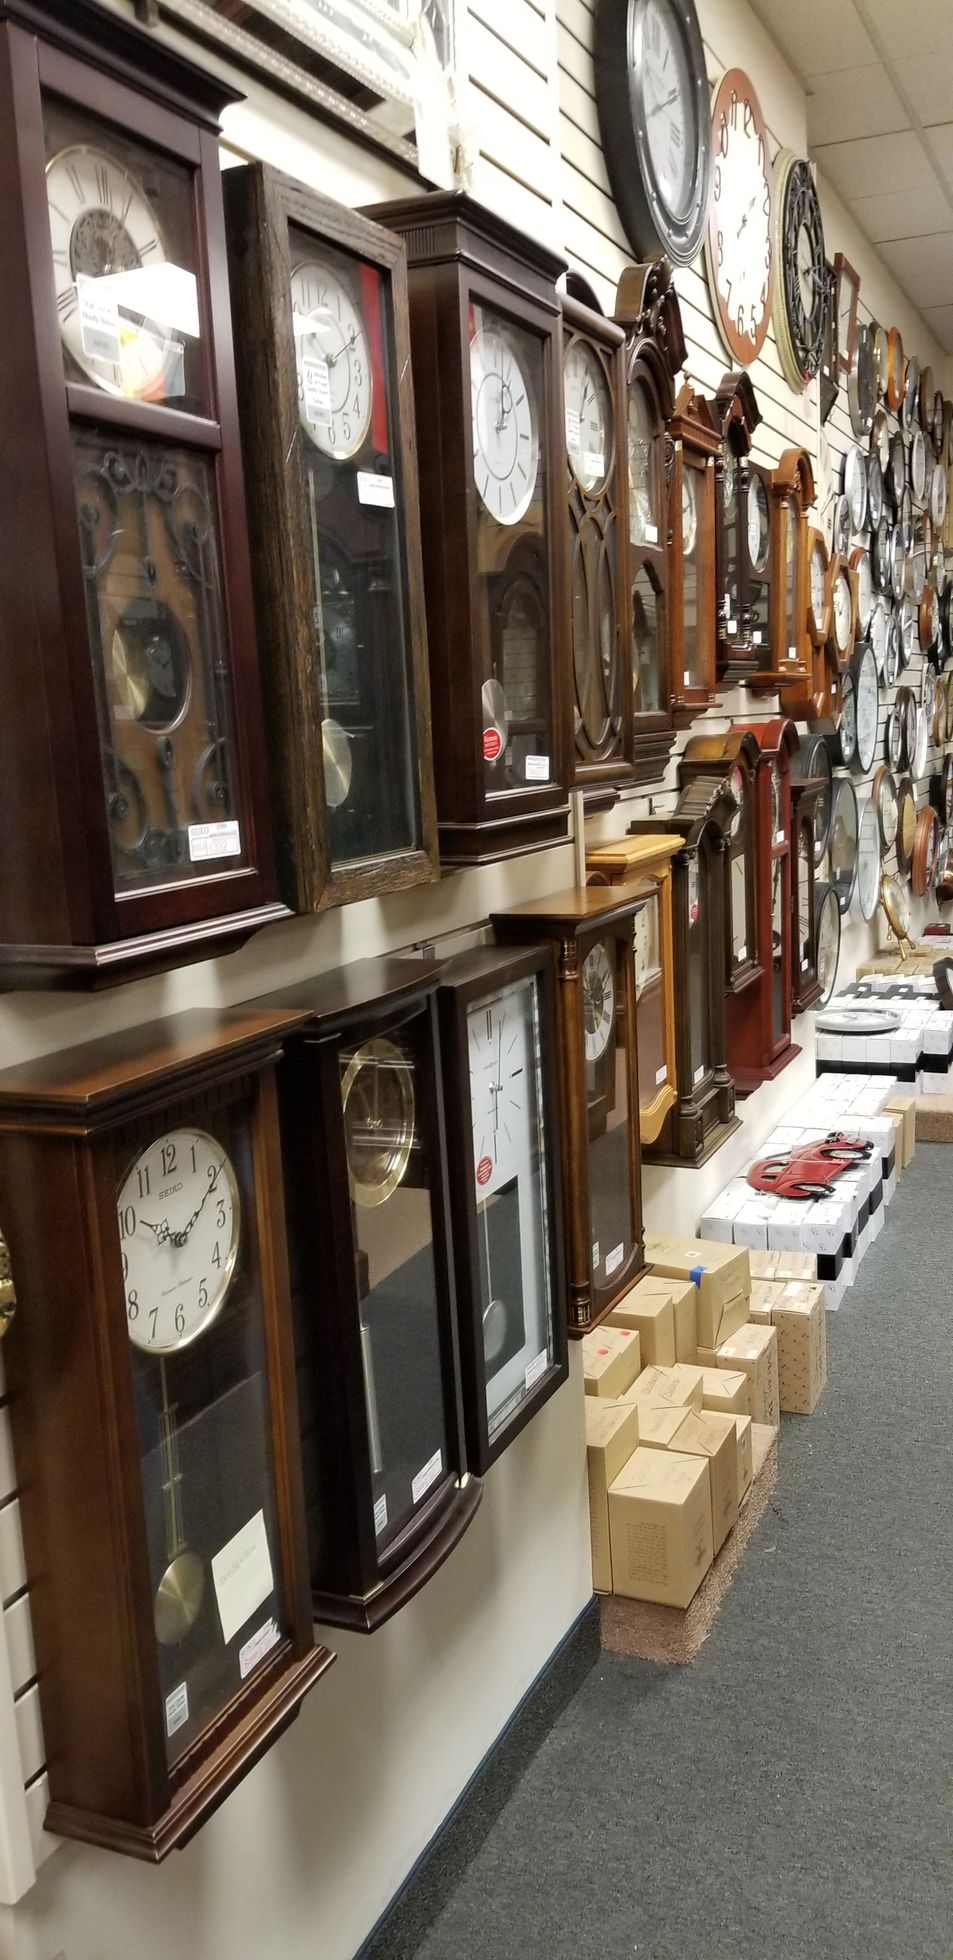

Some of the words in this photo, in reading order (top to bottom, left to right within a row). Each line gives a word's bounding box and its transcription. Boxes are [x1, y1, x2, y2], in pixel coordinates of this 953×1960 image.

[301, 278, 311, 309] 11
[317, 278, 329, 308] 12
[736, 303, 745, 338] 6
[353, 359, 363, 388] 3
[352, 393, 361, 420] 4
[342, 412, 351, 441] 5
[160, 1143, 177, 1177] 12
[189, 1145, 198, 1174] 1
[137, 1166, 152, 1199] 11
[158, 1183, 184, 1200] SEIKO
[207, 1165, 218, 1194] 2
[119, 1205, 136, 1241] 10
[216, 1199, 227, 1229] 3
[211, 1241, 222, 1270] 4
[128, 1289, 139, 1321] 8
[198, 1278, 209, 1308] 5
[148, 1306, 160, 1340] 7
[174, 1303, 186, 1334] 6
